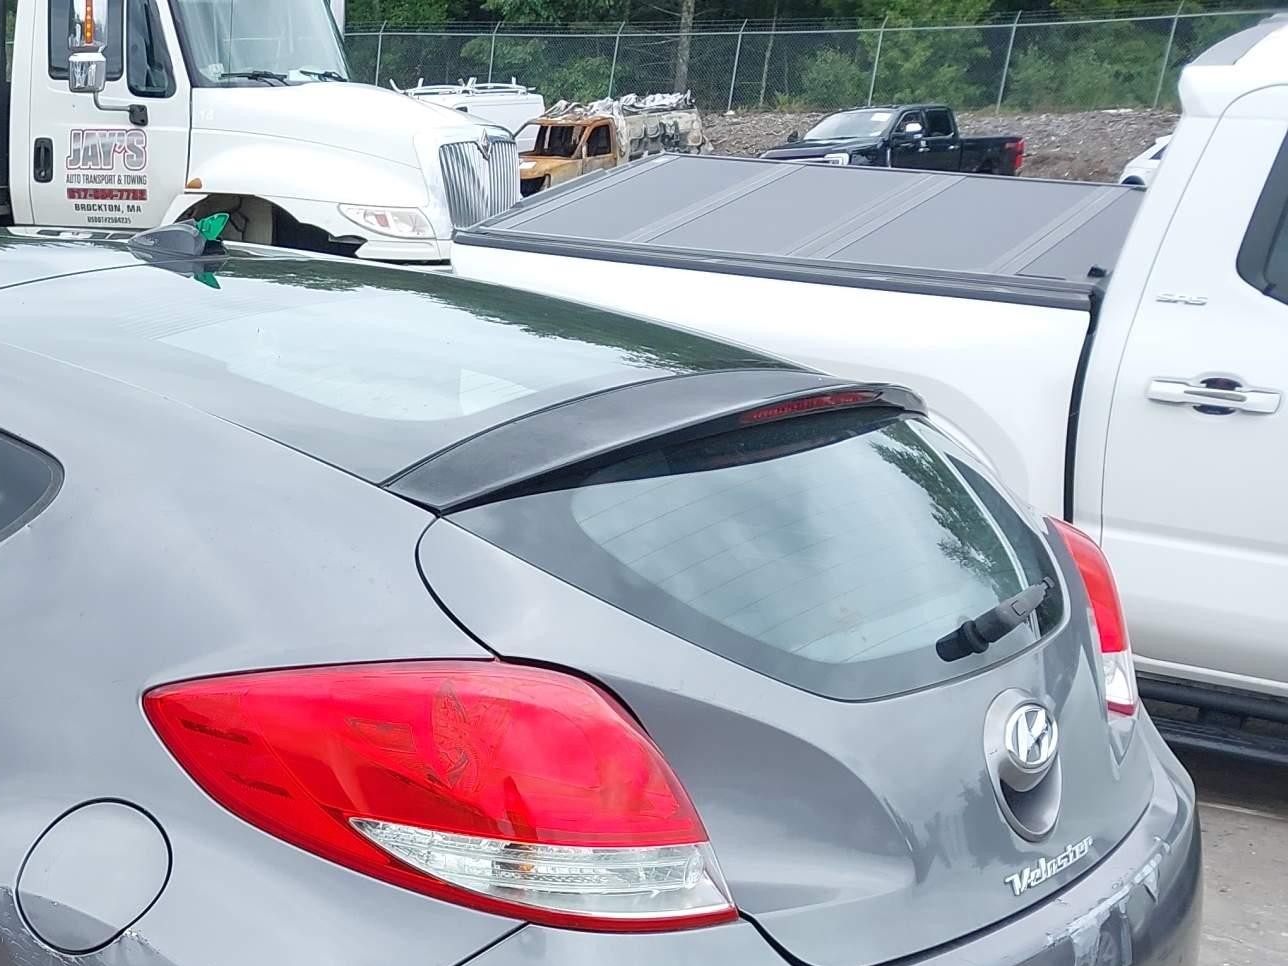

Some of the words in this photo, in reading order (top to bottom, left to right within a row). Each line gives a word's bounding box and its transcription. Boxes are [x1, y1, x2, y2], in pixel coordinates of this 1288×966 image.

[66, 129, 147, 171] JAY'S
[66, 174, 81, 184] AUTO
[82, 174, 116, 185] TRANSPORT
[123, 175, 147, 185] TOWING
[74, 203, 124, 213] BROCKTON,
[127, 204, 141, 213] MA
[1004, 835, 1093, 896] Veloster
